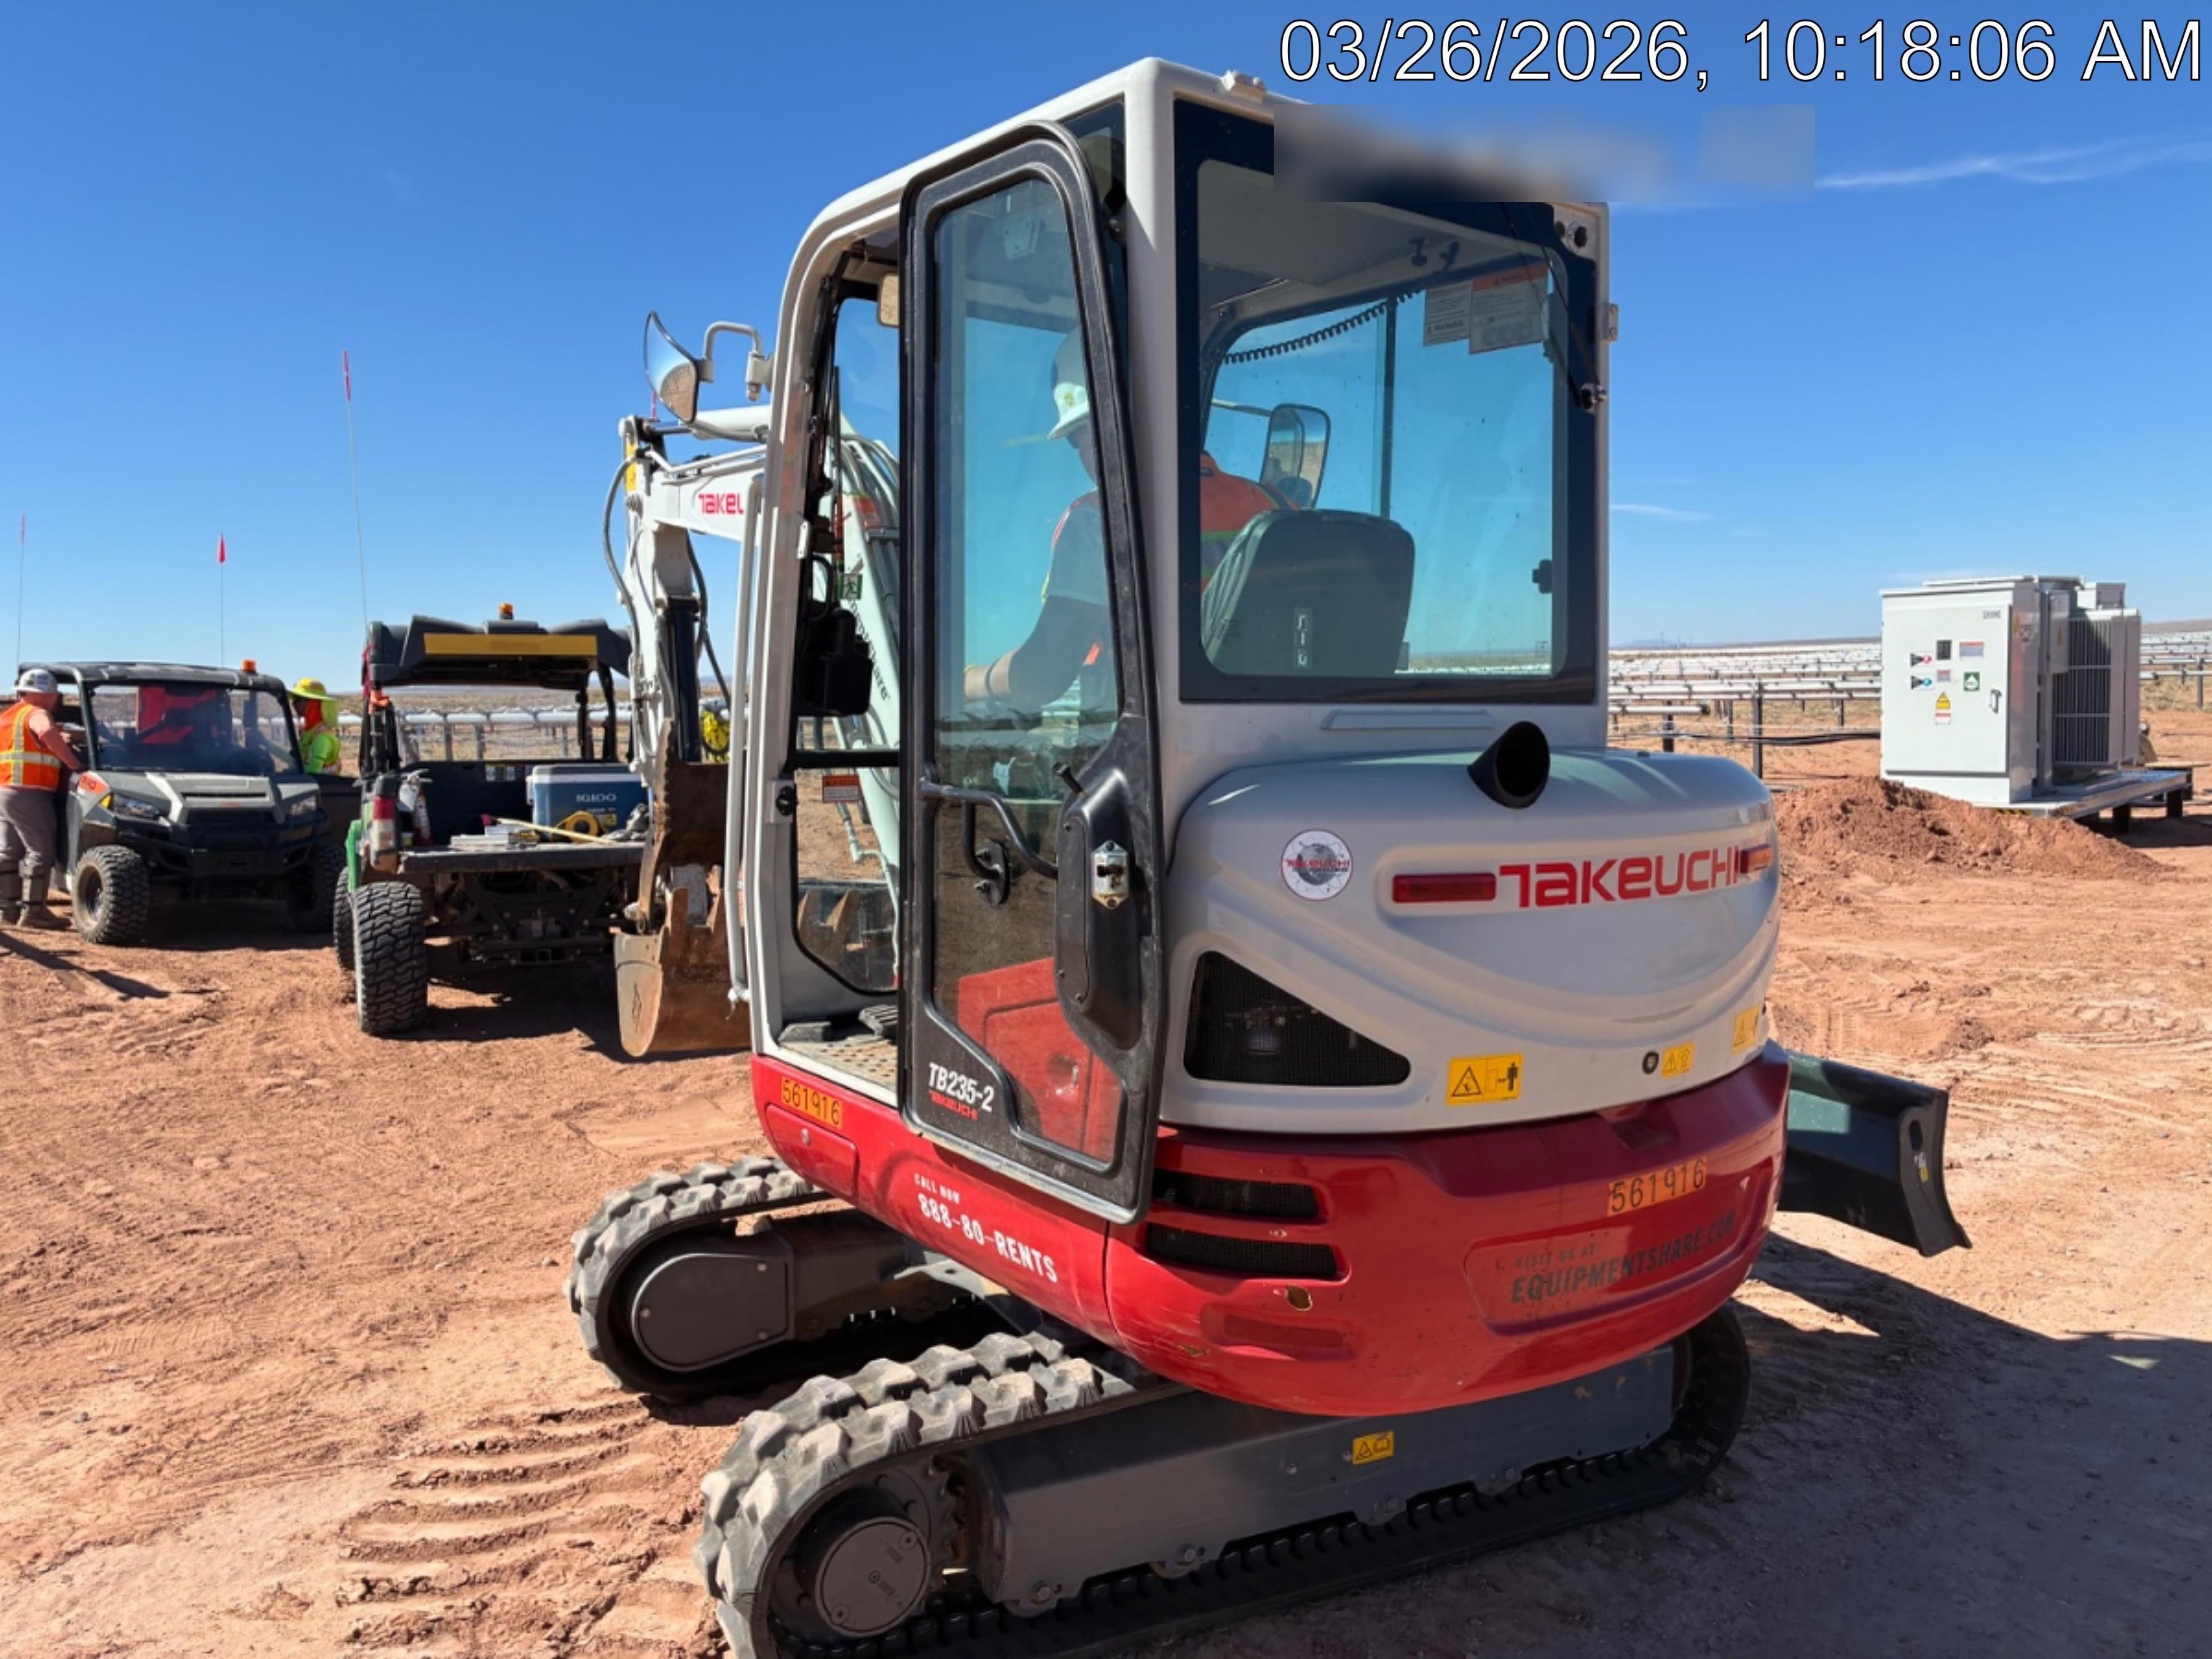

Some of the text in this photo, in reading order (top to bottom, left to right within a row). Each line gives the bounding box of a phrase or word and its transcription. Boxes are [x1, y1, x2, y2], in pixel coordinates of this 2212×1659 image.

[576, 793, 616, 802] IGLOO
[1499, 845, 1740, 908] TAKEUCHI
[783, 1079, 839, 1125] 561916
[928, 1061, 995, 1113] TB235-2
[914, 1173, 960, 1204] CALL NOW
[1611, 1159, 1704, 1212] 561916
[918, 1193, 1058, 1284] 888-80-RENTS
[1514, 1243, 1596, 1269] VISIT US AT
